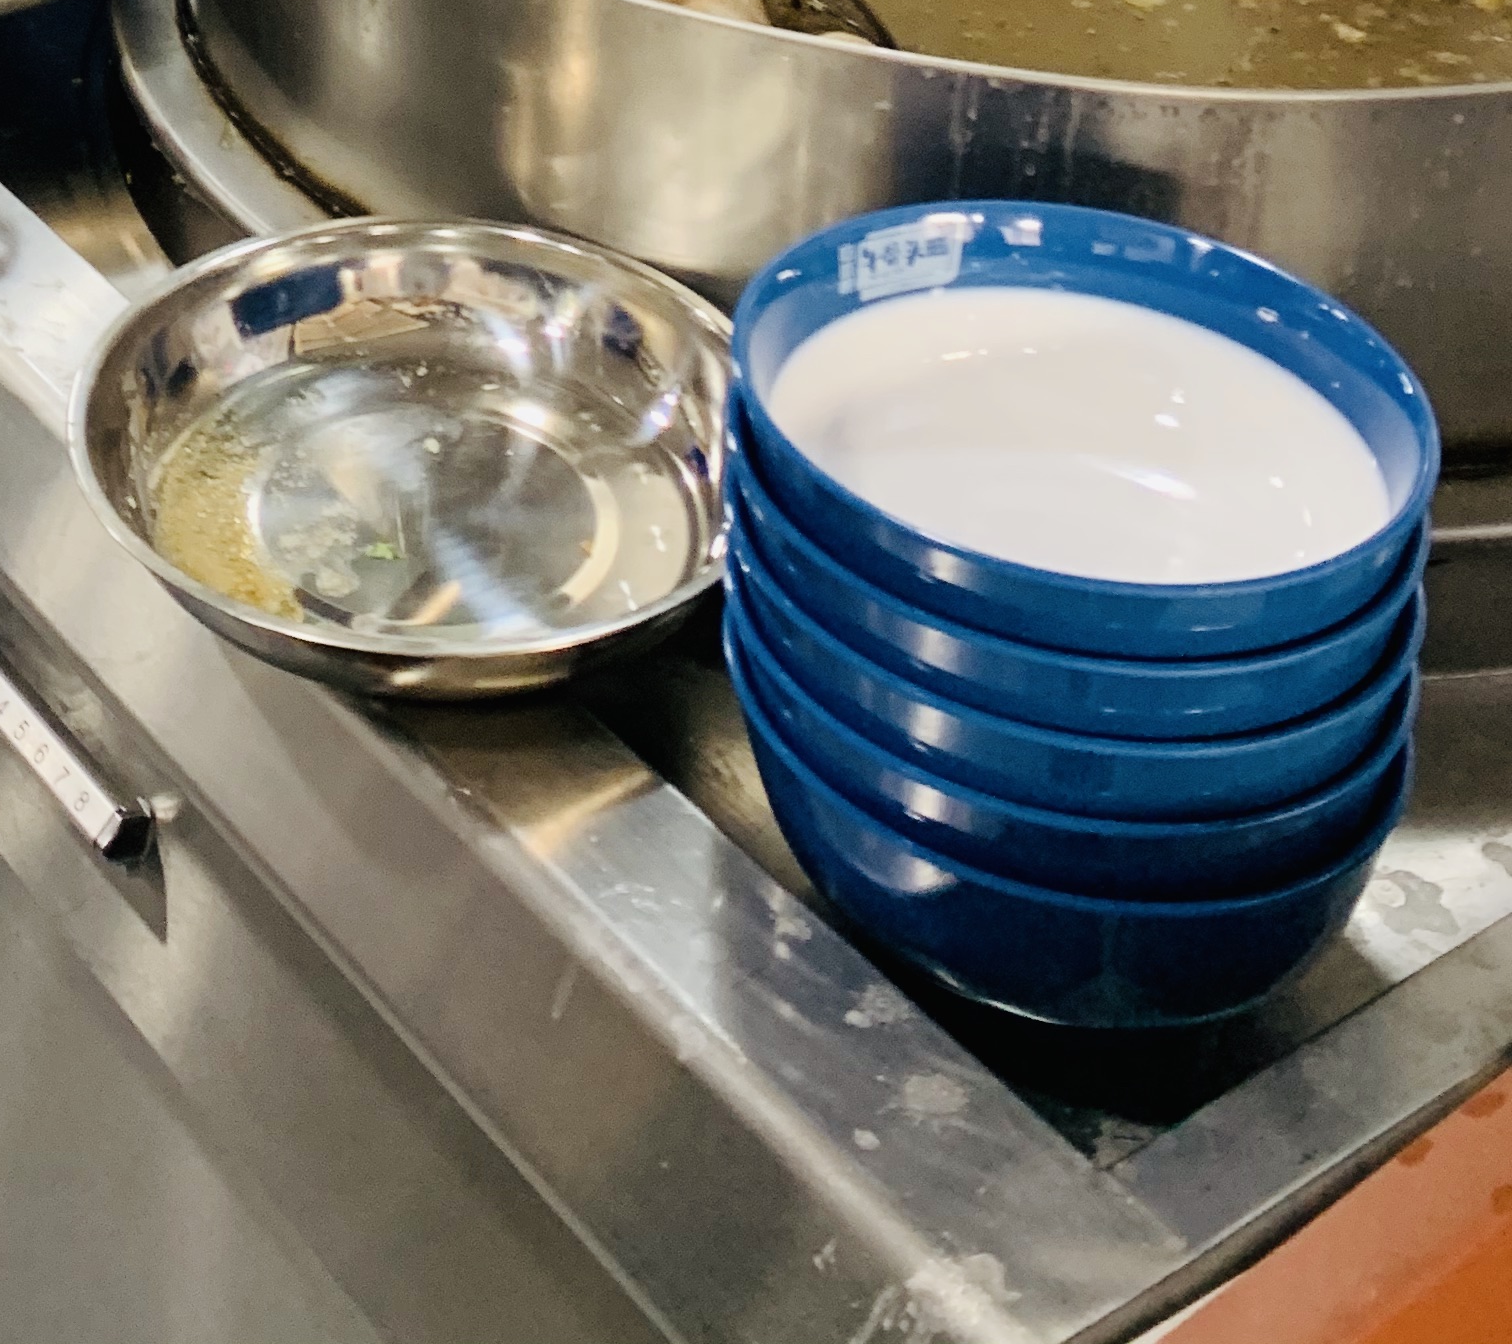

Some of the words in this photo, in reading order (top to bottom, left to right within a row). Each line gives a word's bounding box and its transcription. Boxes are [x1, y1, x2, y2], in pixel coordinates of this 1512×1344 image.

[13, 719, 30, 741] 5
[33, 743, 50, 764] 6
[55, 765, 71, 785] 7
[73, 790, 90, 812] 8
